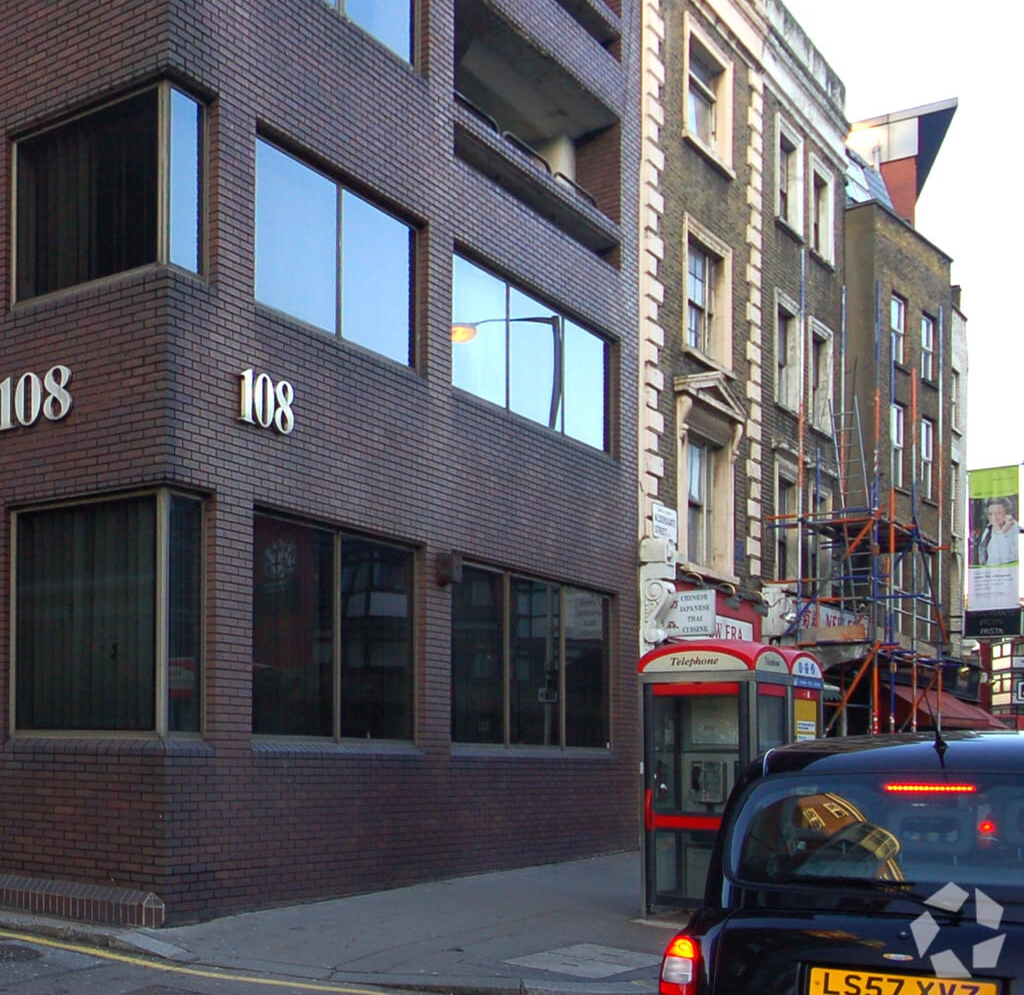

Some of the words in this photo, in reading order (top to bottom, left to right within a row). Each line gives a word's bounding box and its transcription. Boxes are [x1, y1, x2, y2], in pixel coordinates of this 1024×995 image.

[237, 368, 296, 435] 108
[680, 594, 709, 602] CHINESE
[679, 604, 711, 612] JAPANESE
[687, 615, 703, 623] THAI
[682, 626, 709, 634] CUISINE
[725, 624, 743, 640] ERA
[670, 656, 719, 668] Telephone
[822, 972, 905, 995] LS57
